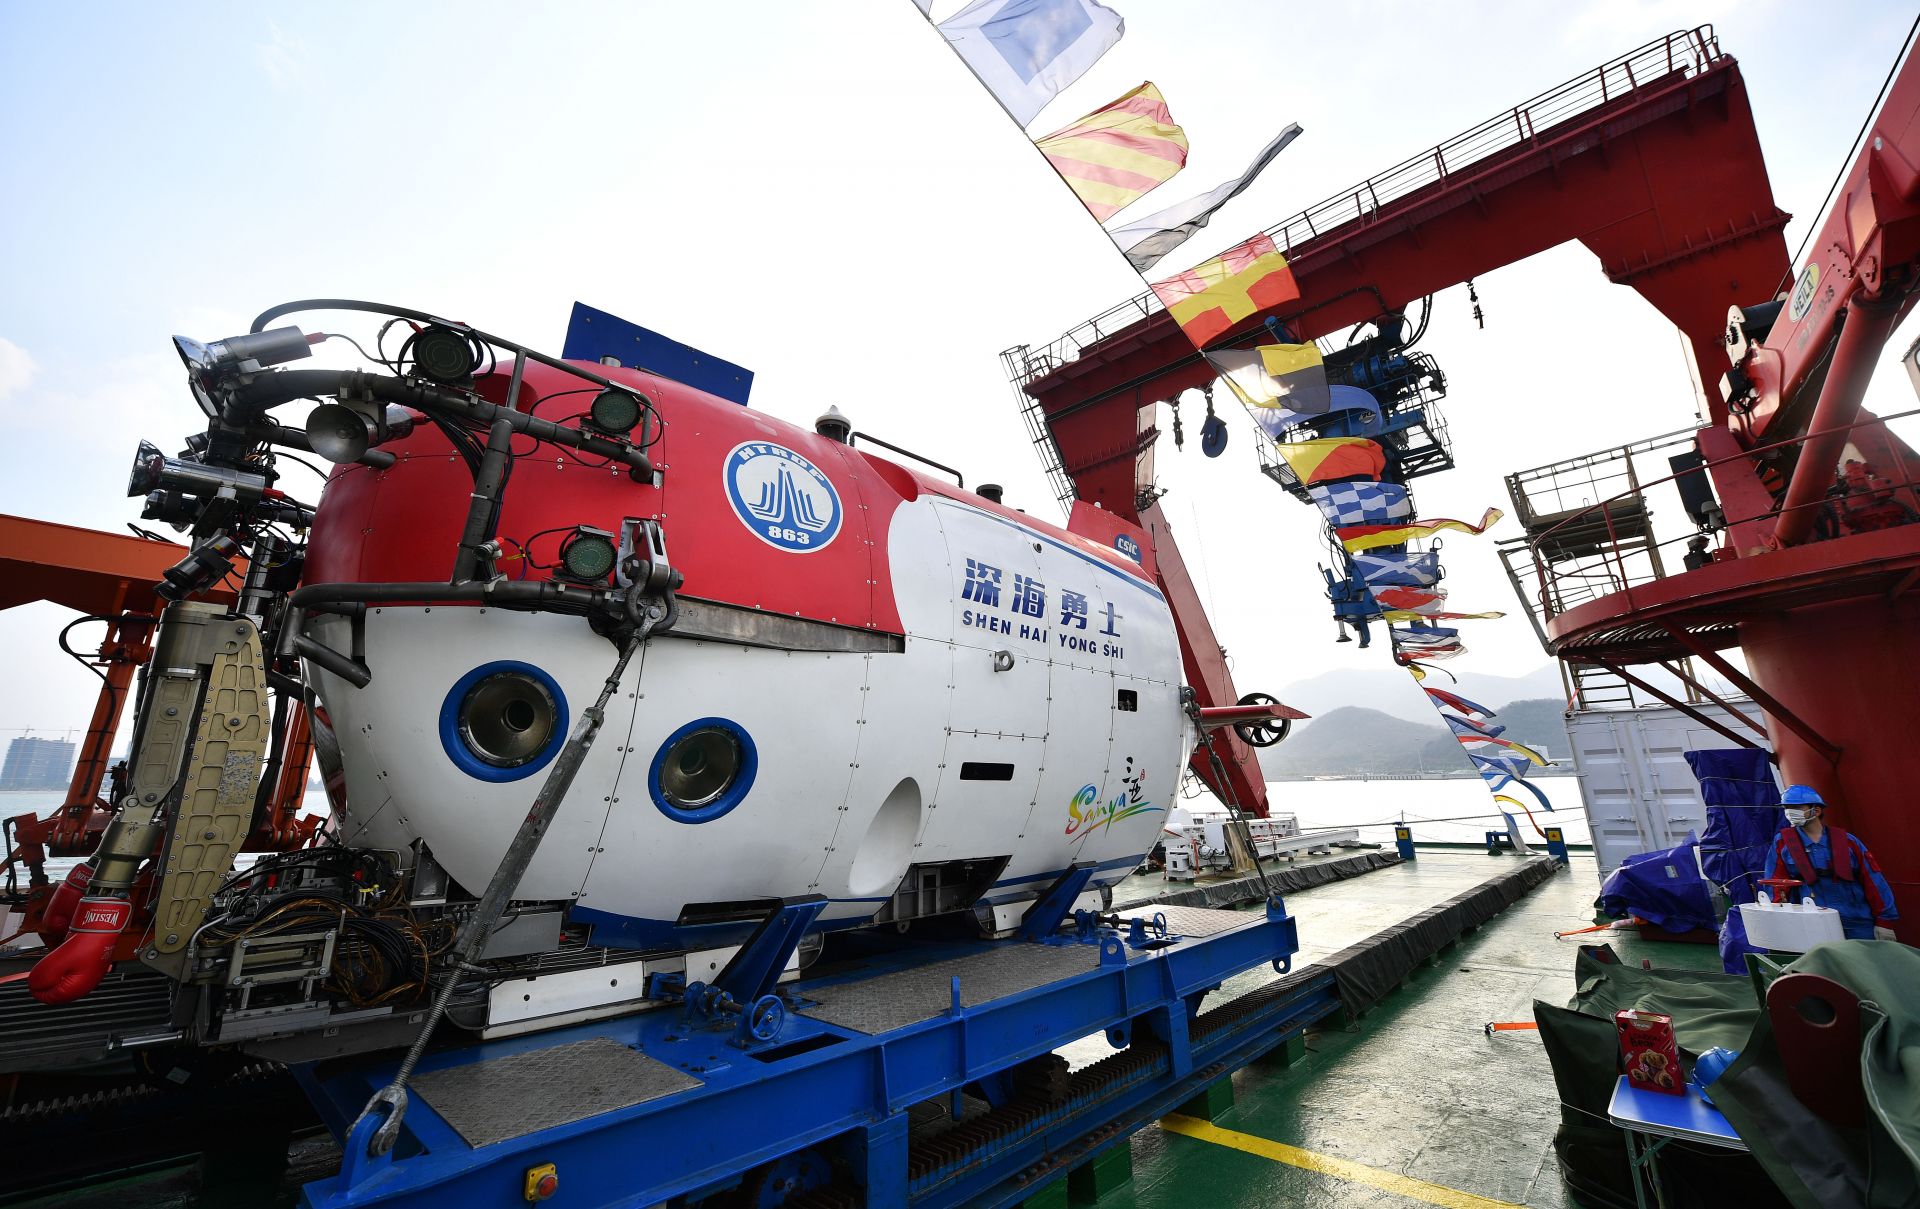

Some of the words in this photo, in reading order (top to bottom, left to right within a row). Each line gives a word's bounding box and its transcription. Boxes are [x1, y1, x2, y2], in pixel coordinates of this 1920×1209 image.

[1793, 279, 1814, 317] HEILA
[737, 445, 825, 482] HTRDP
[768, 525, 810, 545] 863
[1117, 537, 1138, 556] CSIC
[961, 557, 1124, 638] 深海勇士
[962, 610, 1012, 636] SHEN
[1019, 624, 1048, 644] HAI
[1059, 633, 1098, 655] YONG
[1102, 643, 1125, 660] SHI
[1064, 783, 1126, 838] Sanya
